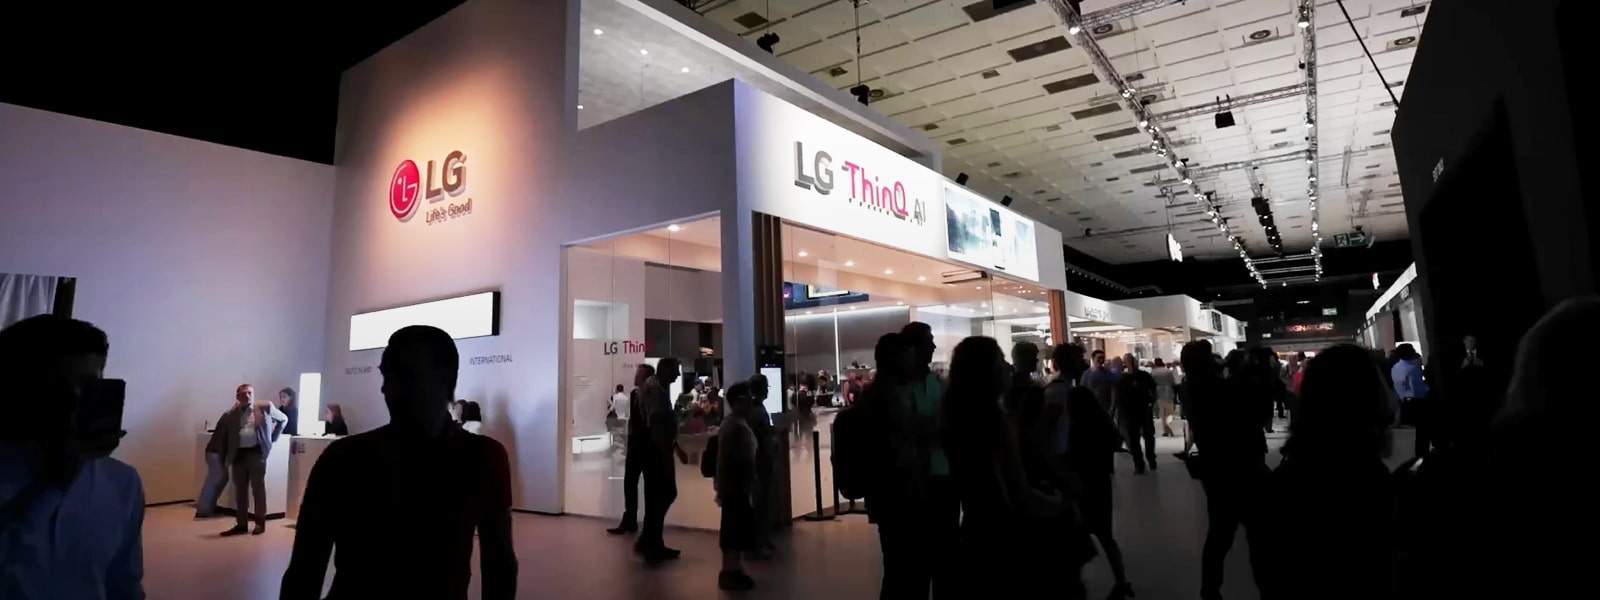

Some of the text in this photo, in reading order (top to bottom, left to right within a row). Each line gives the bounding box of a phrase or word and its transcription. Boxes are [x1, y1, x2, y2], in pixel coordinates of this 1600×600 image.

[425, 150, 467, 203] LG
[793, 141, 926, 225] LG ThinQ AI
[447, 198, 473, 219] Good
[604, 340, 652, 355] LG Thin
